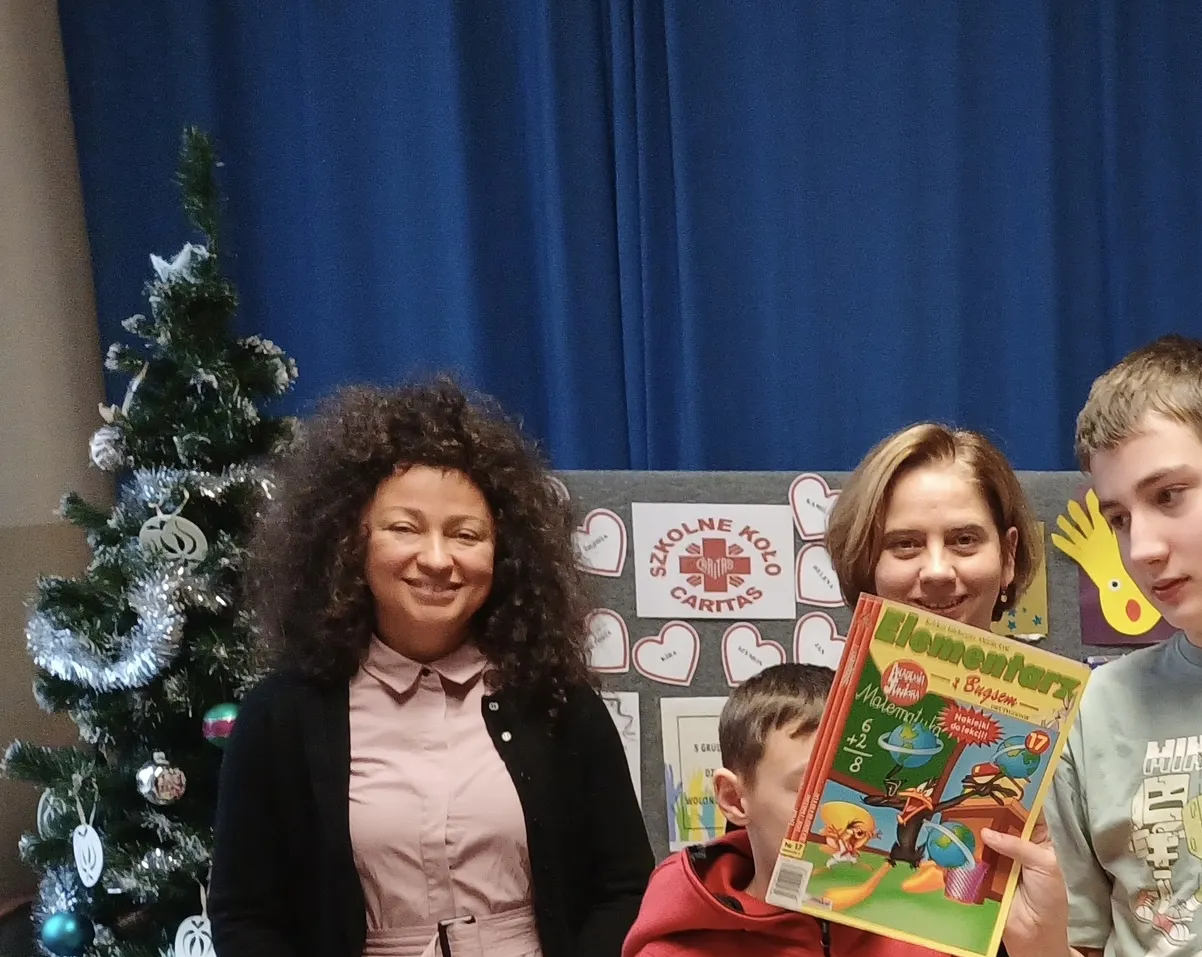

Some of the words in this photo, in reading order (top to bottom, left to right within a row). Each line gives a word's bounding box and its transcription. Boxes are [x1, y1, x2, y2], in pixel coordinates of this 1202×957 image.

[649, 517, 733, 578] SZKOLNE
[738, 525, 782, 577] KOŁO
[696, 556, 734, 580] CARITAS
[670, 585, 763, 613] CARITAS
[873, 606, 1081, 701] Elementarz
[963, 674, 1018, 707] Bugsem
[854, 682, 942, 738] Matematka
[861, 718, 874, 733] 6
[950, 722, 961, 732] do
[954, 712, 990, 730] Naklejki
[1027, 732, 1049, 751] 17
[849, 757, 863, 773] 8
[686, 797, 715, 805] WOLON
